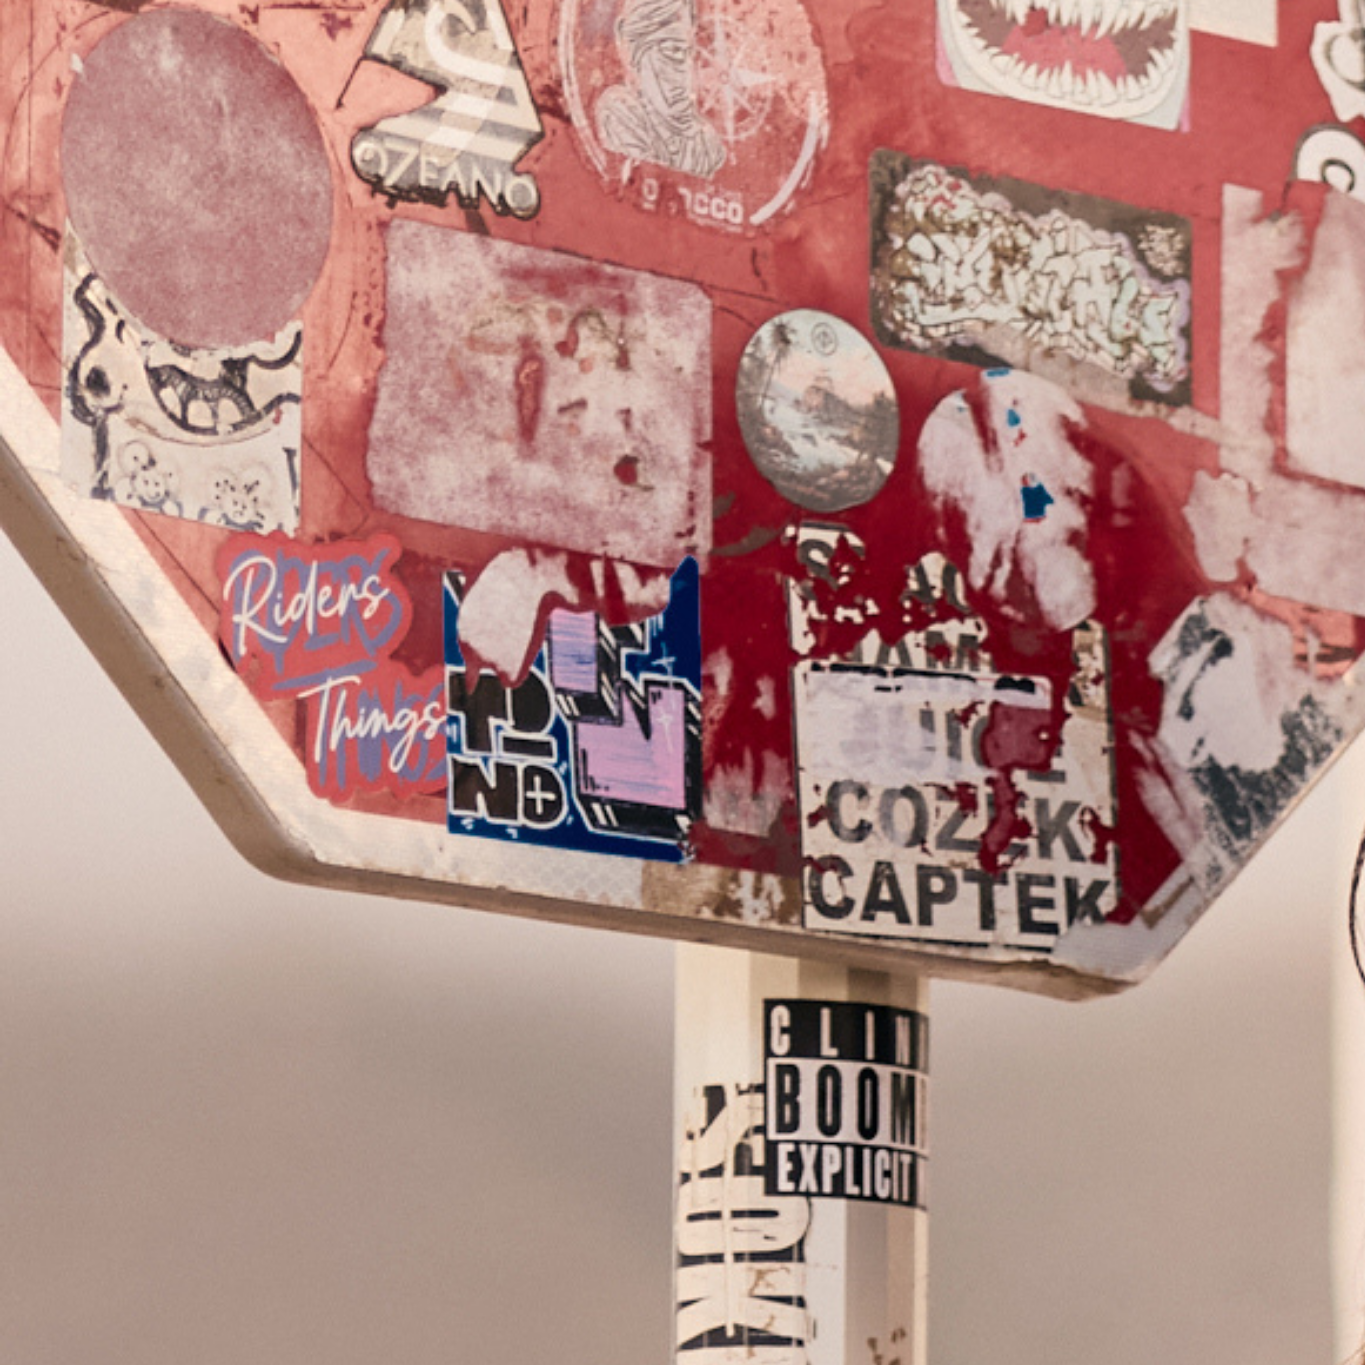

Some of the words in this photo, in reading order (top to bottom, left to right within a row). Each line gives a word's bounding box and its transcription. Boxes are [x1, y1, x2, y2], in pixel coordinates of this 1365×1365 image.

[222, 554, 391, 657] Riders
[296, 676, 448, 774] Things
[808, 854, 1111, 936] CAPTEK
[769, 1004, 928, 1066] CLIN
[777, 1143, 914, 1202] EXPLICIT
